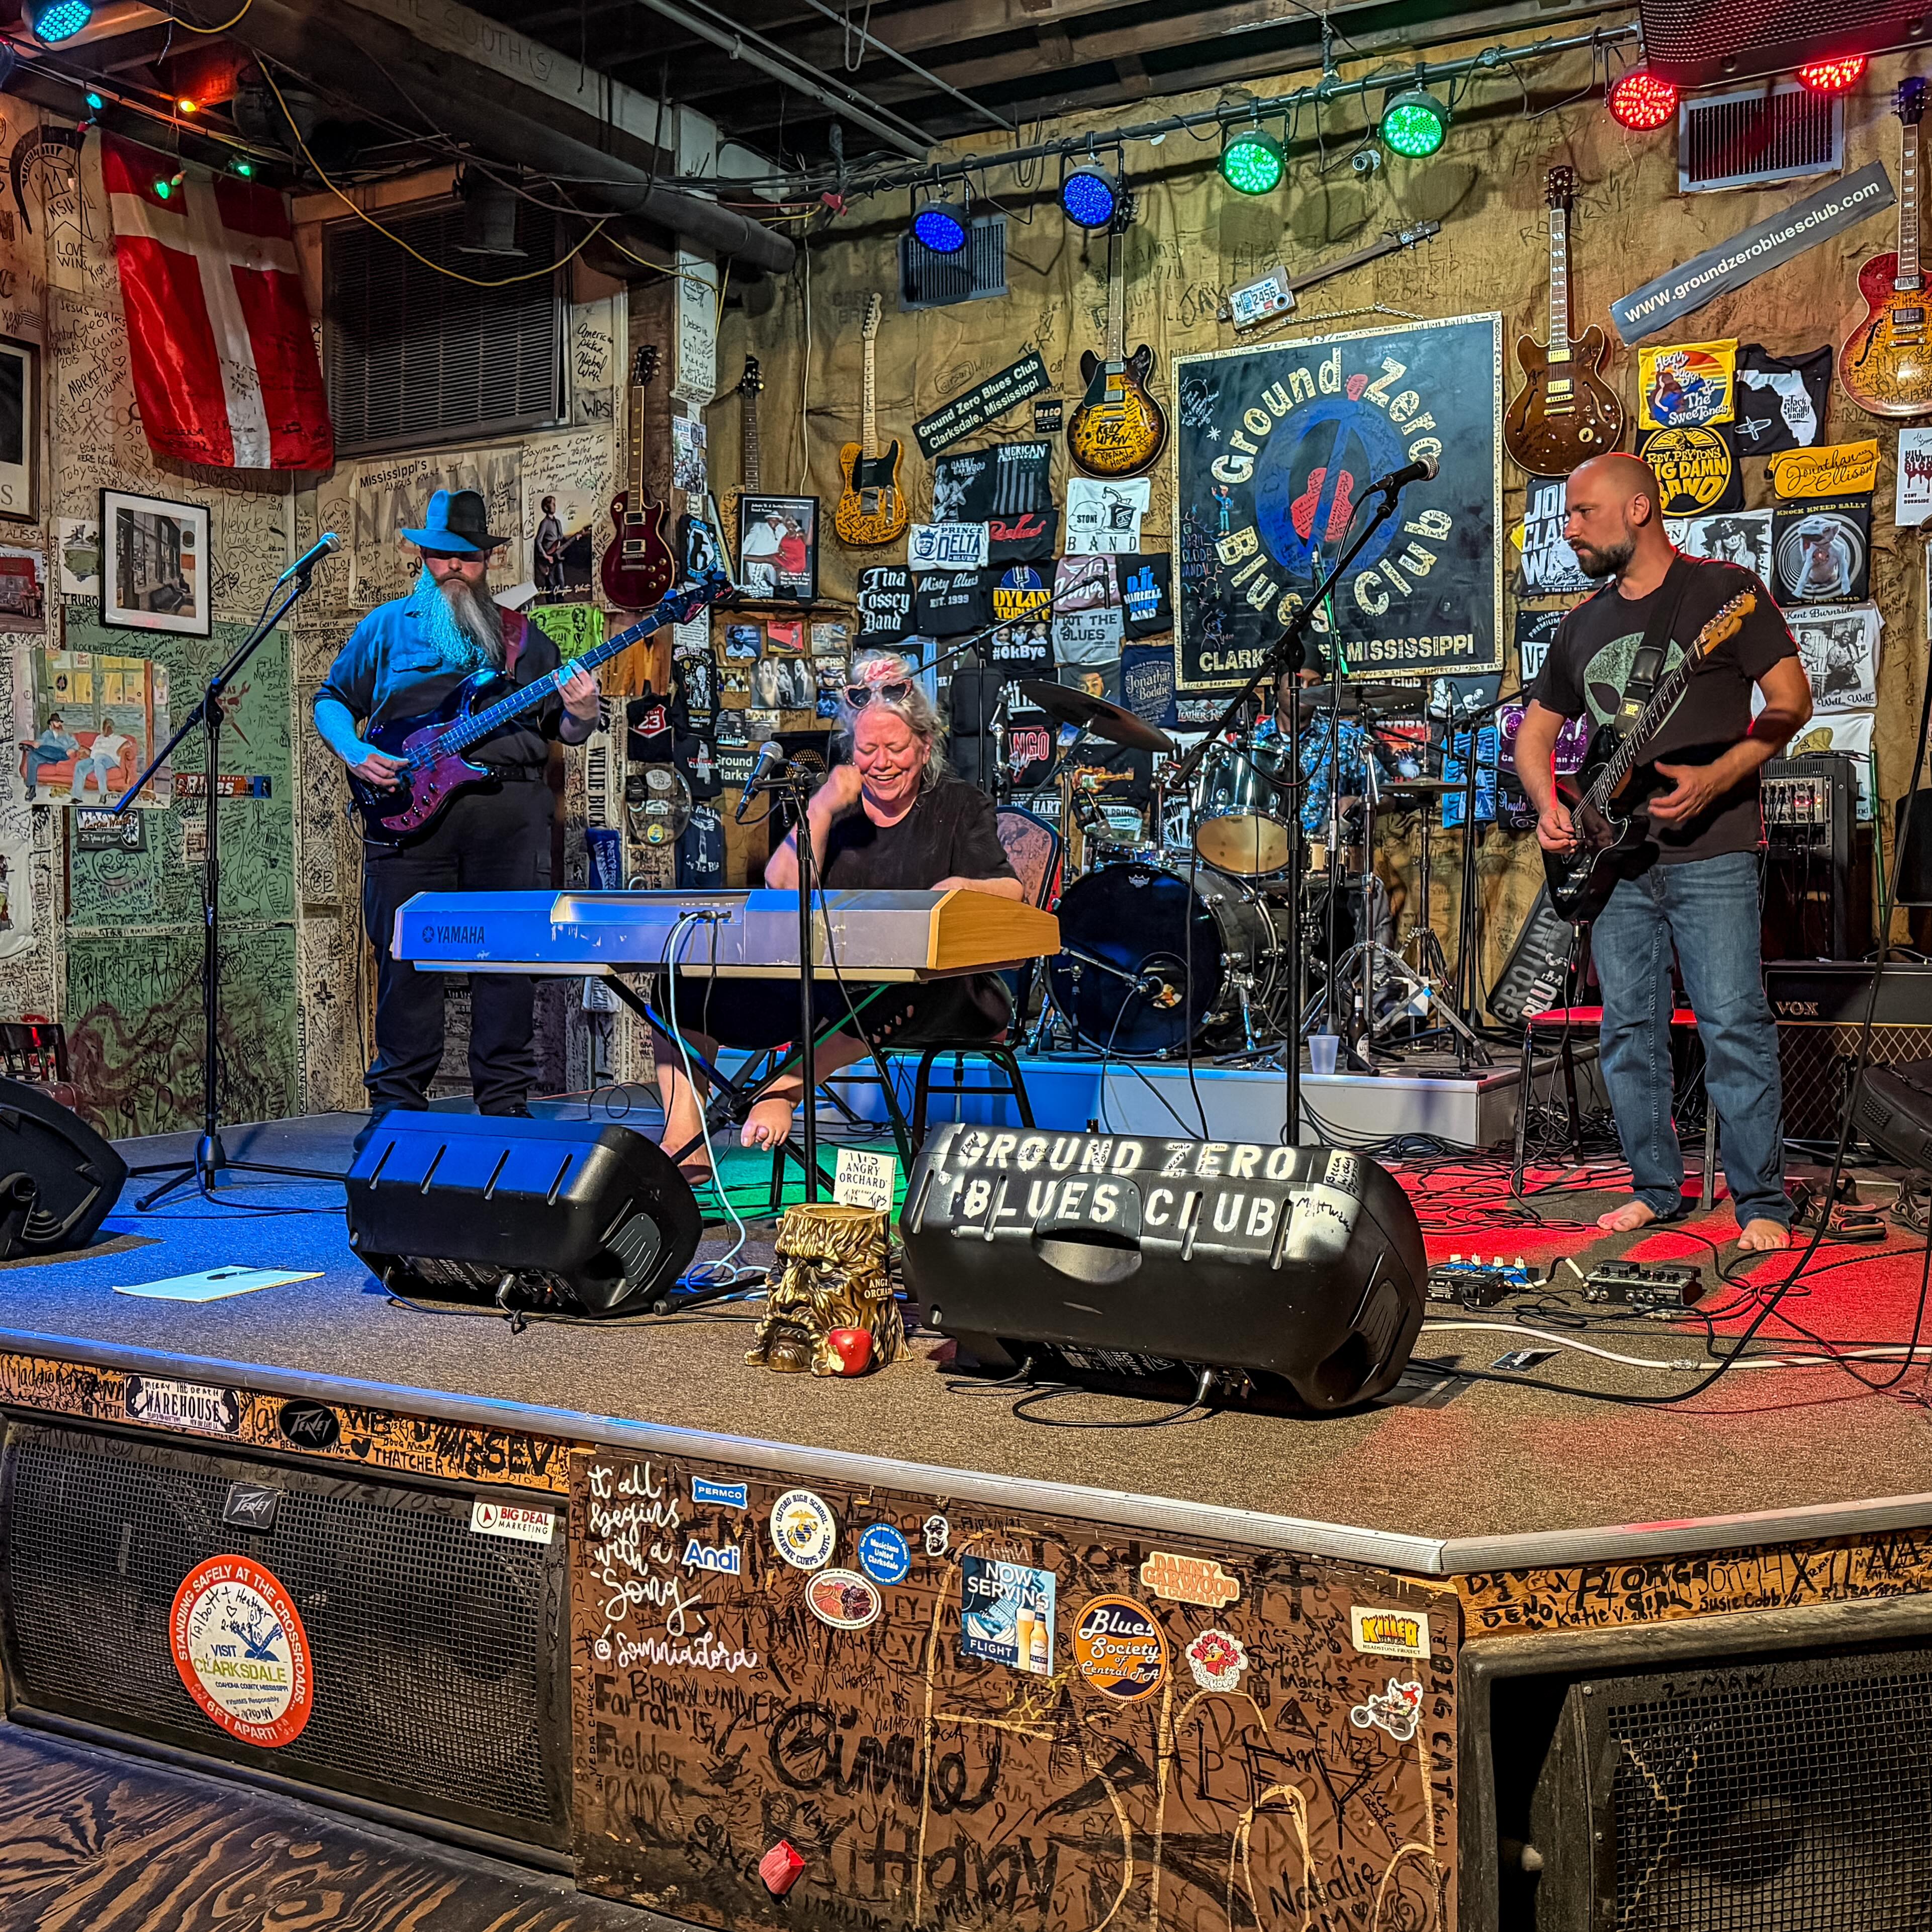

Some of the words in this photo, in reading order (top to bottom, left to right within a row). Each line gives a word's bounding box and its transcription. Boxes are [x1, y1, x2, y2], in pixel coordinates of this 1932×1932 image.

[57, 240, 87, 258] LOVE
[1624, 179, 1881, 323] www.groundzerobluesclub.com
[919, 409, 955, 437] Ground
[956, 396, 980, 415] Zero
[981, 377, 1012, 399] Blues
[1014, 359, 1039, 380] Club
[1684, 391, 1711, 408] The
[930, 413, 983, 448] Clarksdale,
[984, 376, 1039, 416] Mississippi
[1211, 347, 1342, 484] Ground
[1362, 357, 1442, 462] Zero
[1646, 453, 1673, 463] REV.
[1680, 457, 1727, 477] DAMN
[1786, 449, 1858, 491] Jonathan
[360, 460, 427, 489] Mississippi's
[1816, 464, 1874, 491] Ellison
[1524, 482, 1567, 524] JO
[1659, 476, 1724, 509] BAND
[1077, 514, 1097, 523] STONE
[937, 534, 980, 561] DELTA
[1067, 536, 1136, 551] BAND
[1353, 509, 1452, 616] Club
[918, 577, 950, 595] Misty
[952, 573, 978, 588] Blues
[948, 594, 969, 605] 1999
[993, 590, 1051, 608] DYLAN
[1063, 615, 1083, 625] GOT
[1089, 614, 1117, 625] THE
[1809, 605, 1855, 619] Burnside
[1060, 627, 1105, 640] BLUES
[992, 645, 1046, 660] #OkBye
[1346, 634, 1474, 662] MISSISSIPPI
[638, 715, 661, 729] 23
[588, 747, 606, 791] WILLIE
[588, 795, 606, 827] BUCK
[1033, 801, 1061, 814] HART
[437, 926, 485, 944] YAMAHA
[1776, 1000, 1818, 1017] VOX
[958, 1132, 1142, 1175] GROUND
[1160, 1142, 1296, 1180] ZERO
[839, 1173, 887, 1189] ORCHARD
[846, 1162, 880, 1176] ANGRY
[962, 1178, 1119, 1223] BLUES
[1145, 1188, 1274, 1236] CLUB
[145, 1389, 220, 1422] WAREHOUSE
[375, 1447, 444, 1476] THATCHER
[618, 1461, 662, 1499] all
[698, 1486, 743, 1500] PERMCO
[500, 1508, 519, 1521] BIG
[521, 1511, 549, 1525] DEAL
[776, 1497, 792, 1522] OXFORD
[793, 1494, 808, 1503] HIGH
[809, 1499, 828, 1524] SCHOOL
[498, 1521, 548, 1535] MARKETING
[590, 1499, 680, 1546] begins
[594, 1532, 648, 1577] with
[651, 1541, 673, 1565] a
[686, 1543, 738, 1572] Andi
[776, 1529, 795, 1559] MARINE
[796, 1555, 818, 1565] CORPS
[874, 1548, 894, 1560] United
[868, 1555, 899, 1571] Clarksdale
[986, 1562, 1032, 1587] NOW
[1154, 1554, 1218, 1579] DANNY
[968, 1577, 1049, 1609] SERVING
[1142, 1567, 1237, 1598] GARWOOD
[603, 1568, 702, 1636] Song
[1168, 1588, 1223, 1606] COMPANY
[176, 1590, 194, 1661] STANDING
[192, 1565, 232, 1592] SAFELY
[236, 1566, 248, 1582] AT
[253, 1574, 277, 1602] THE
[1078, 1609, 1156, 1640] Blues
[1361, 1614, 1420, 1648] KILLER
[210, 1644, 236, 1657] VISIT
[970, 1639, 1012, 1658] FLIGHT
[1031, 1655, 1047, 1664] FLIGHT
[1090, 1637, 1159, 1664] Society
[1114, 1654, 1128, 1667] of
[194, 1658, 287, 1682] CLARKSDALE
[1081, 1661, 1127, 1677] Central
[1130, 1668, 1160, 1682] PA
[207, 1700, 230, 1725] 6FT
